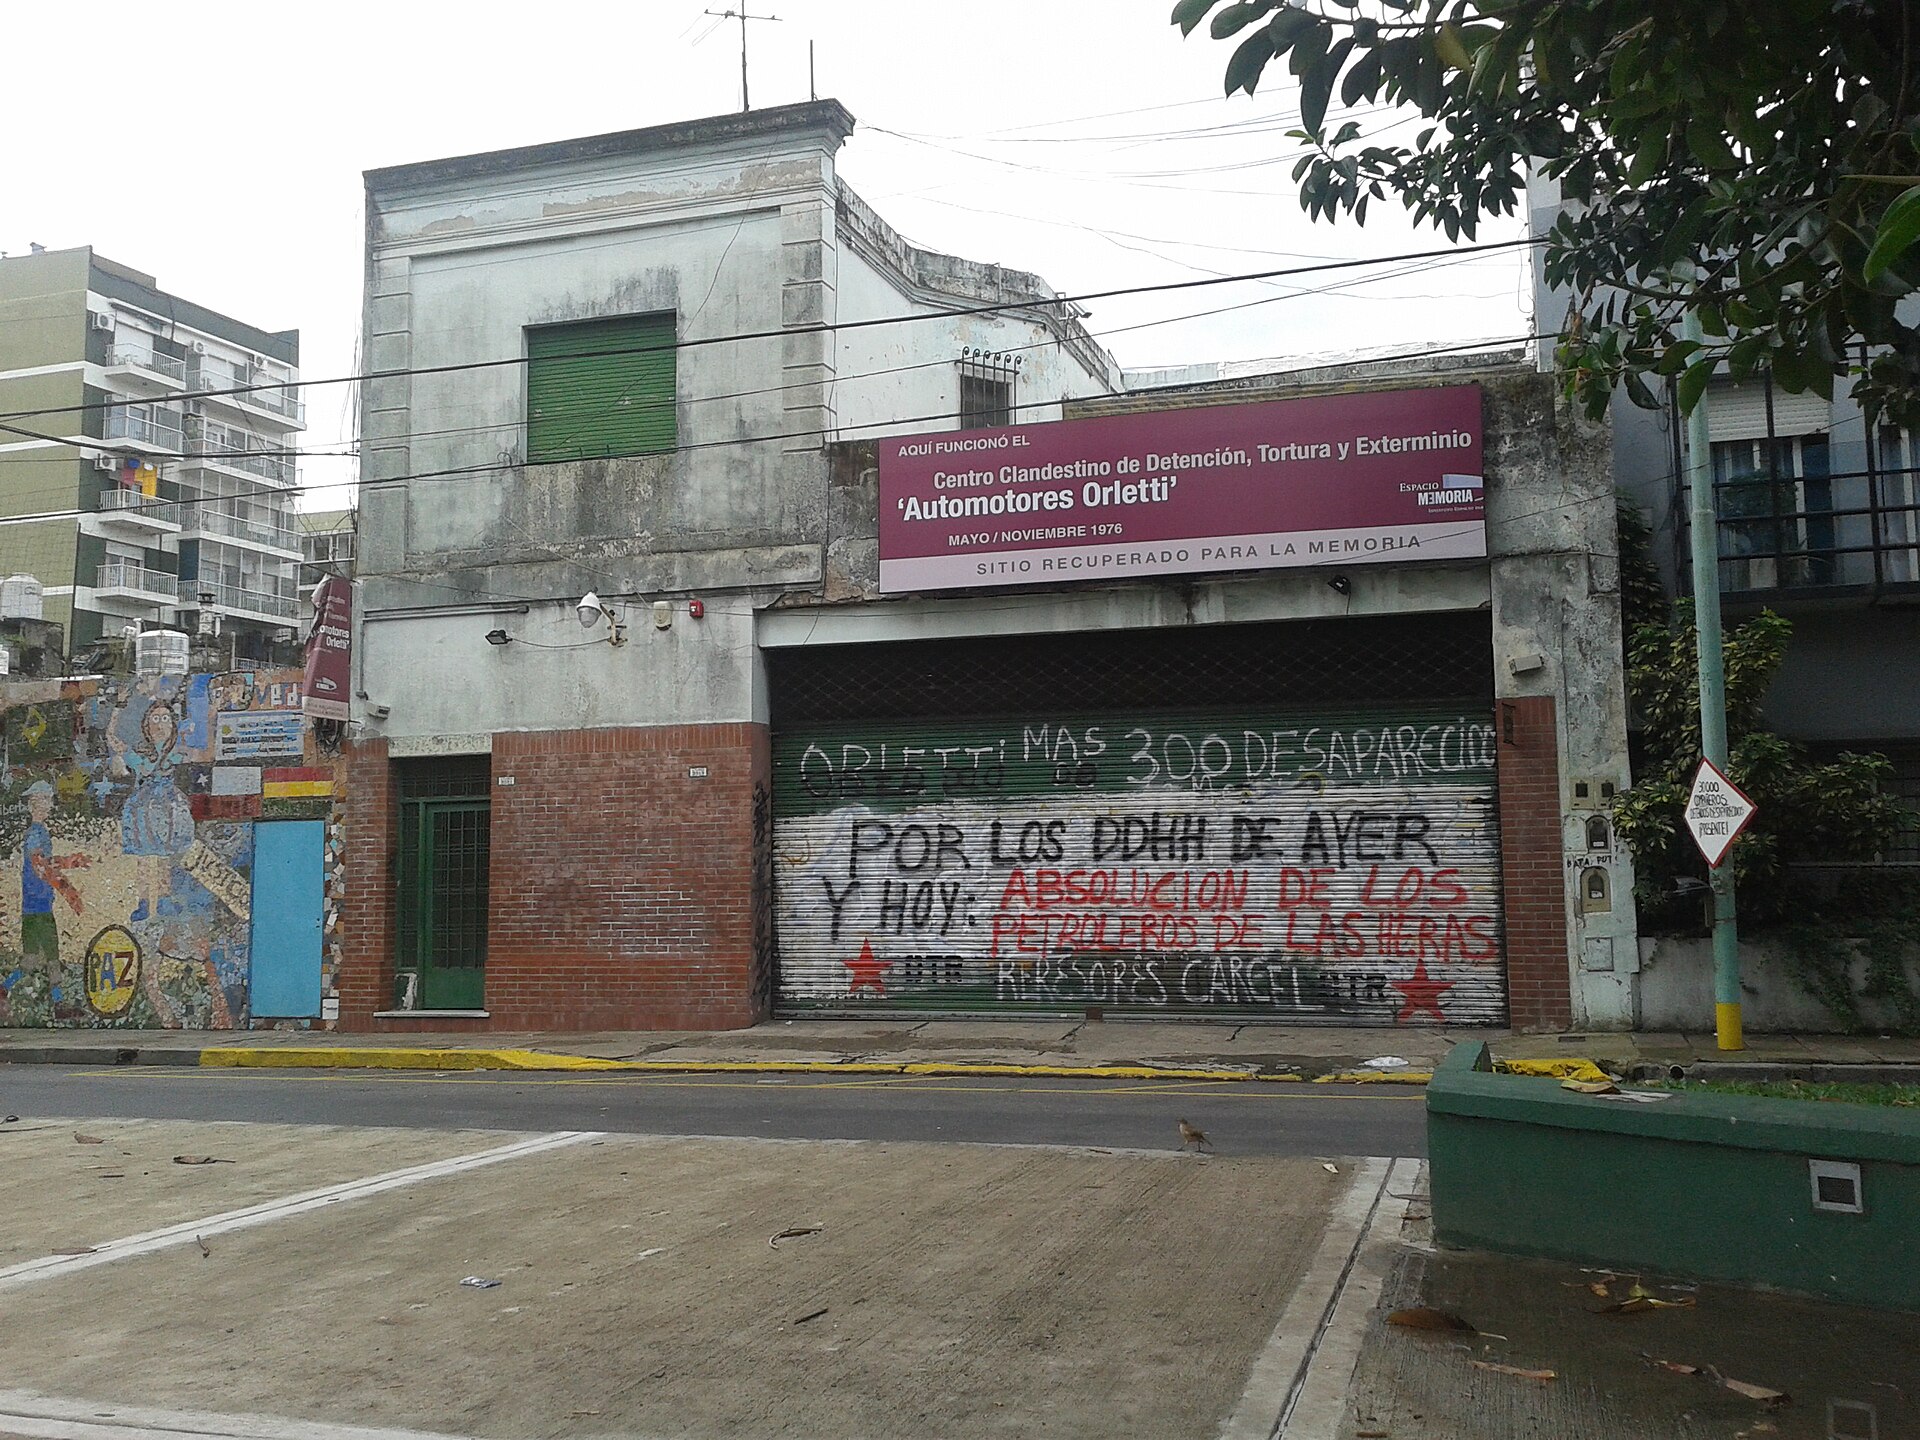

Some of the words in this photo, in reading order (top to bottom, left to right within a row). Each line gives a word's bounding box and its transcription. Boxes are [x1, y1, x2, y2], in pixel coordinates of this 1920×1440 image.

[898, 440, 932, 457] AQUÍ
[935, 434, 1009, 454] FUNCIONÓ
[1012, 435, 1030, 447] EL
[934, 469, 994, 490] Centro
[999, 460, 1111, 484] Clandestino
[1116, 456, 1140, 475] de
[1146, 446, 1252, 472] Detención,
[1257, 440, 1331, 463] Tortura
[1337, 441, 1350, 461] y
[1356, 429, 1472, 456] Exterminio
[948, 532, 990, 546] MAYO
[1001, 525, 1086, 542] NOVIEMBRE
[1090, 522, 1123, 536] 1976
[976, 558, 1031, 576] SITIO
[1041, 549, 1190, 571] RECUPERADO
[1201, 545, 1258, 561] PARA
[1270, 542, 1296, 556] LA
[1308, 535, 1421, 554] MEMORIA
[1023, 724, 1106, 762] MAS
[1124, 728, 1233, 784] 300
[850, 820, 972, 880] POR
[990, 818, 1067, 863] LOS
[1231, 814, 1285, 864] DE
[1301, 810, 1440, 869] AYER
[822, 875, 862, 943] Y
[1001, 866, 1249, 913] ABSOLUCION
[1278, 867, 1337, 911] DE
[1361, 865, 1470, 910] LOS
[991, 912, 1199, 959] PETROLEROS
[1211, 914, 1264, 952] DE
[1286, 911, 1365, 958] LAS
[1378, 912, 1500, 963] HERAS
[89, 951, 135, 993] PAZ
